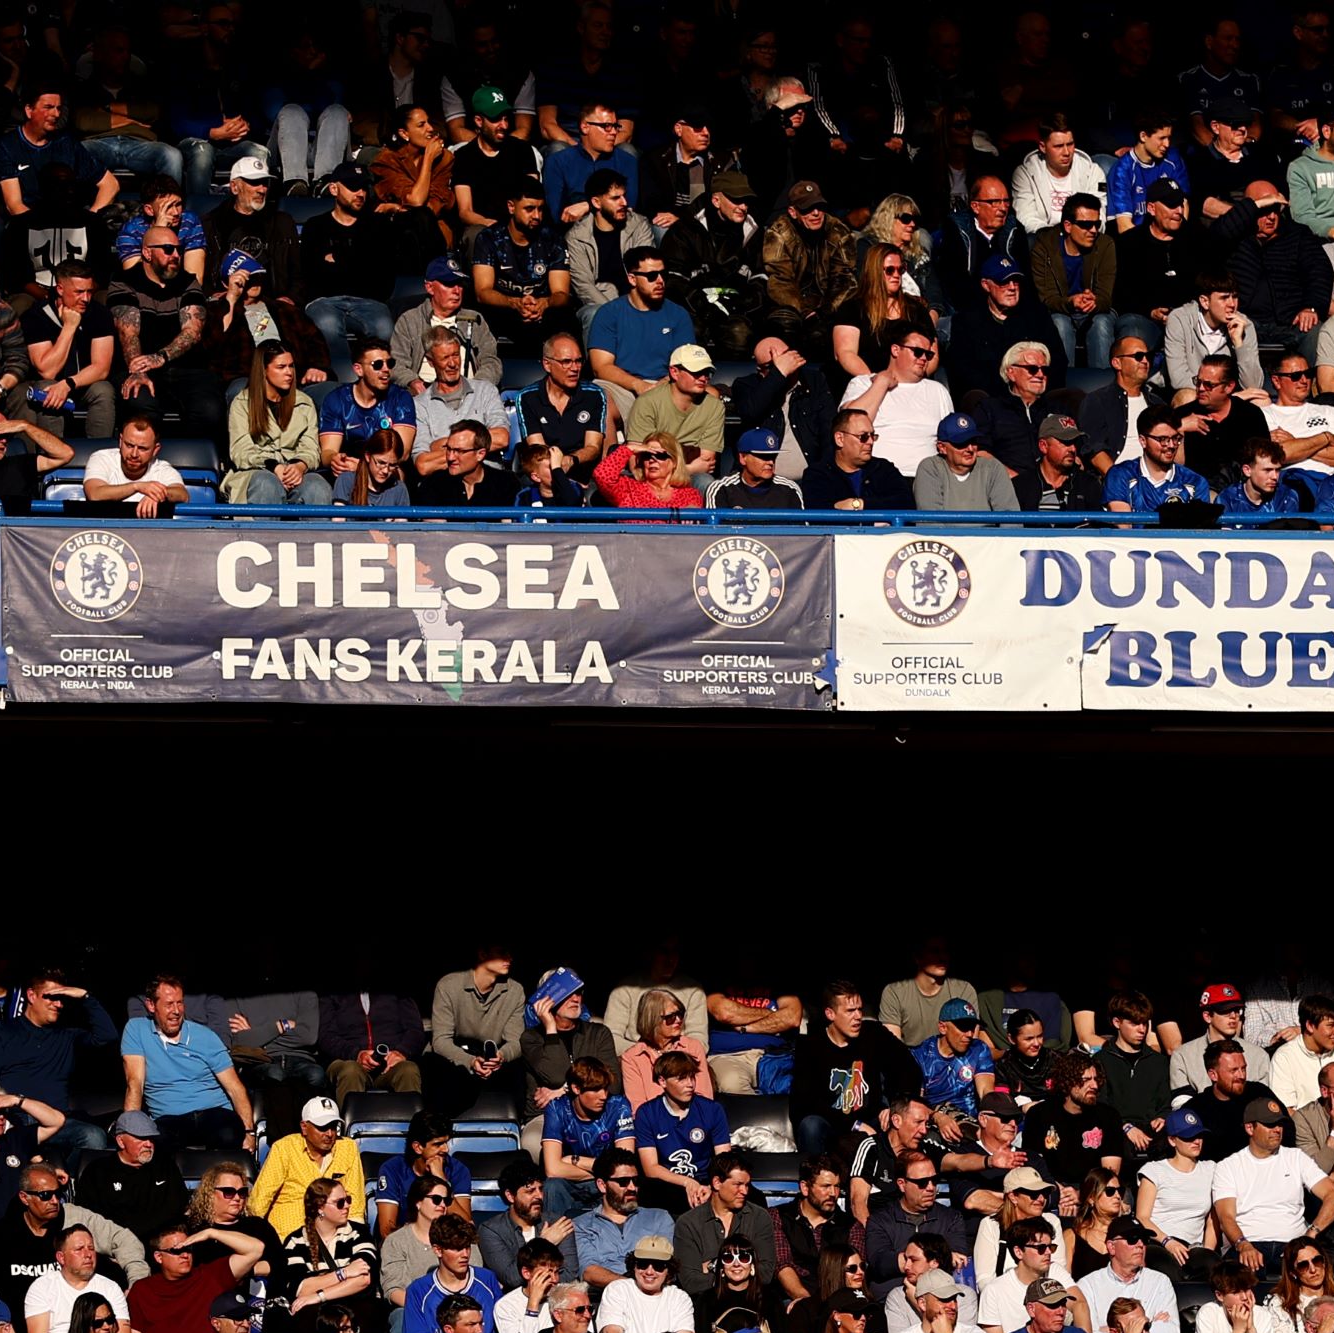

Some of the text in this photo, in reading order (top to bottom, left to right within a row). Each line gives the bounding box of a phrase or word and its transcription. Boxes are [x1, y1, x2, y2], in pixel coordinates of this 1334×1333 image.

[66, 533, 126, 553] CHELSEA
[709, 540, 768, 560] CHELSEA
[897, 541, 955, 561] CHELSEA
[216, 540, 620, 611] CHELSEA
[65, 599, 128, 618] FOOTBALL CLUB
[708, 605, 770, 624] FOOTBALL CLUB
[896, 606, 959, 626] FOOTBALL CLUB
[60, 648, 135, 662] OFFICIAL
[220, 638, 614, 684] FANS KERALA
[701, 655, 775, 668] OFFICIAL
[891, 656, 965, 669] OFFICIAL
[21, 664, 173, 679] SUPPORTERS CLUB
[663, 670, 813, 685] SUPPORTERS CLUB
[853, 673, 1003, 685] SUPPORTERS CLUB
[60, 680, 98, 690] KERALA
[107, 680, 135, 690] INDIA
[702, 685, 740, 695] KERALA
[748, 685, 776, 696] INDIA
[905, 688, 951, 697] DUNDALK
